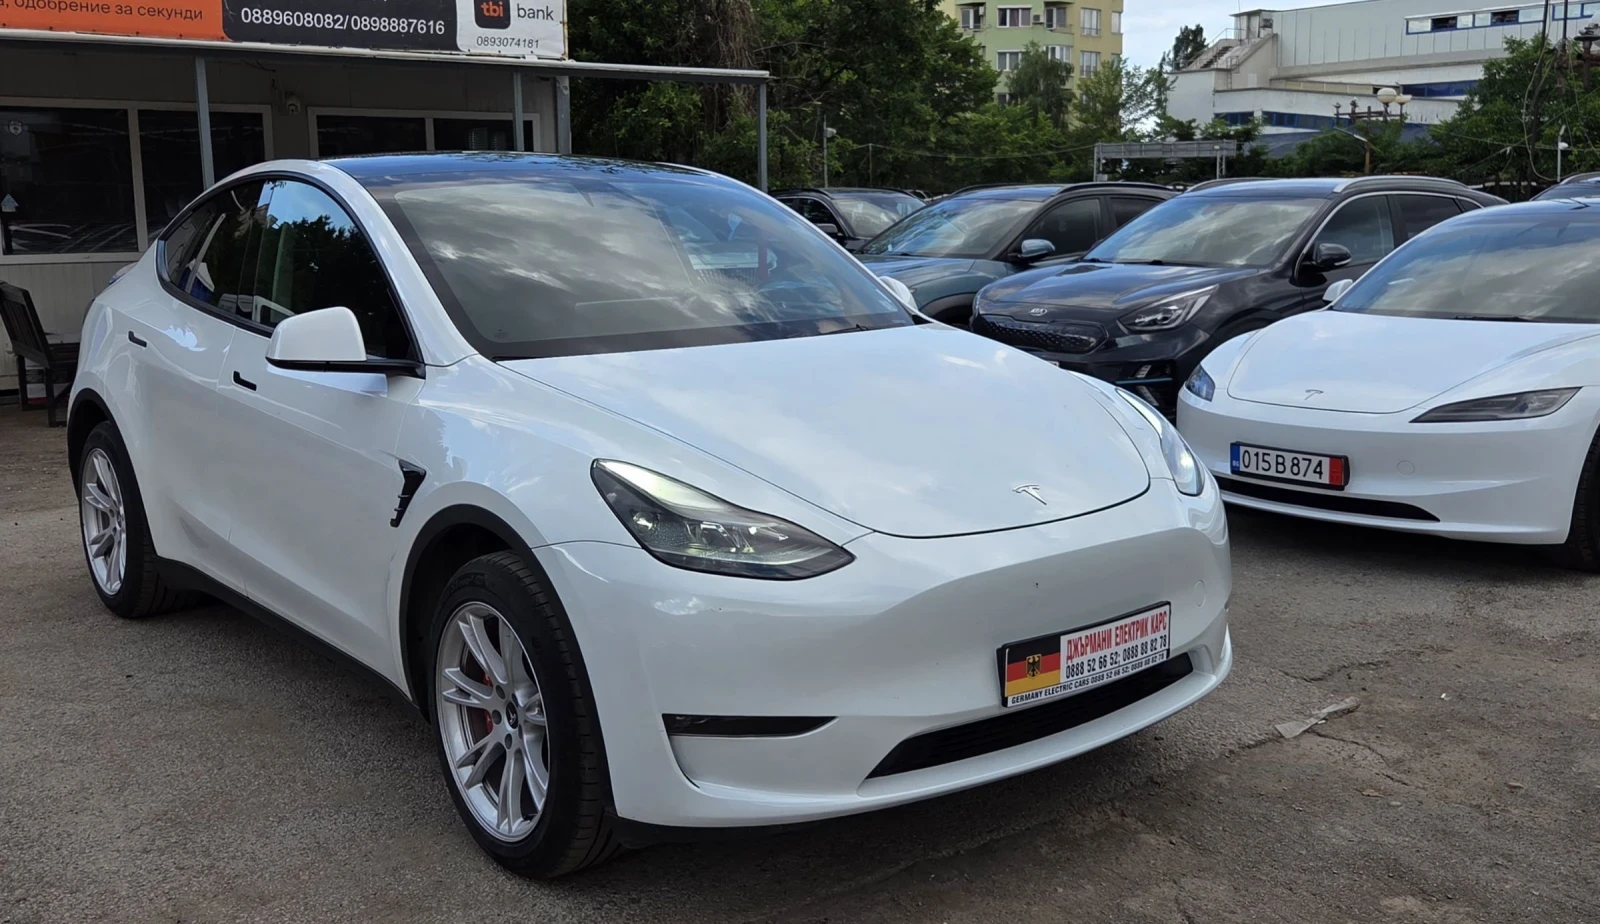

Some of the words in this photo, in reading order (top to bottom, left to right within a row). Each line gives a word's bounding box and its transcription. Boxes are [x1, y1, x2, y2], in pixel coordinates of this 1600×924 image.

[15, 0, 110, 13] одобрение
[115, 5, 133, 15] за
[137, 5, 203, 20] секунди
[481, 2, 504, 17] tbi
[516, 3, 554, 20] bank
[476, 36, 539, 49] 0893074181
[1066, 628, 1112, 665] ДЖЪРМАНИ
[1115, 617, 1149, 647] ЕЛЕКТРИК
[1151, 610, 1167, 635] КАРС
[1066, 661, 1084, 679] 0888
[1087, 658, 1096, 673] 52
[1098, 654, 1107, 669] 66
[1110, 651, 1121, 666] 52;
[1123, 644, 1138, 662] 0888
[1141, 641, 1148, 655] 88
[1150, 637, 1158, 652] 82
[1160, 634, 1167, 649] 78
[1011, 690, 1044, 704] GERMANY
[1044, 682, 1073, 697] ELECTRIC
[1074, 678, 1090, 689] CARS
